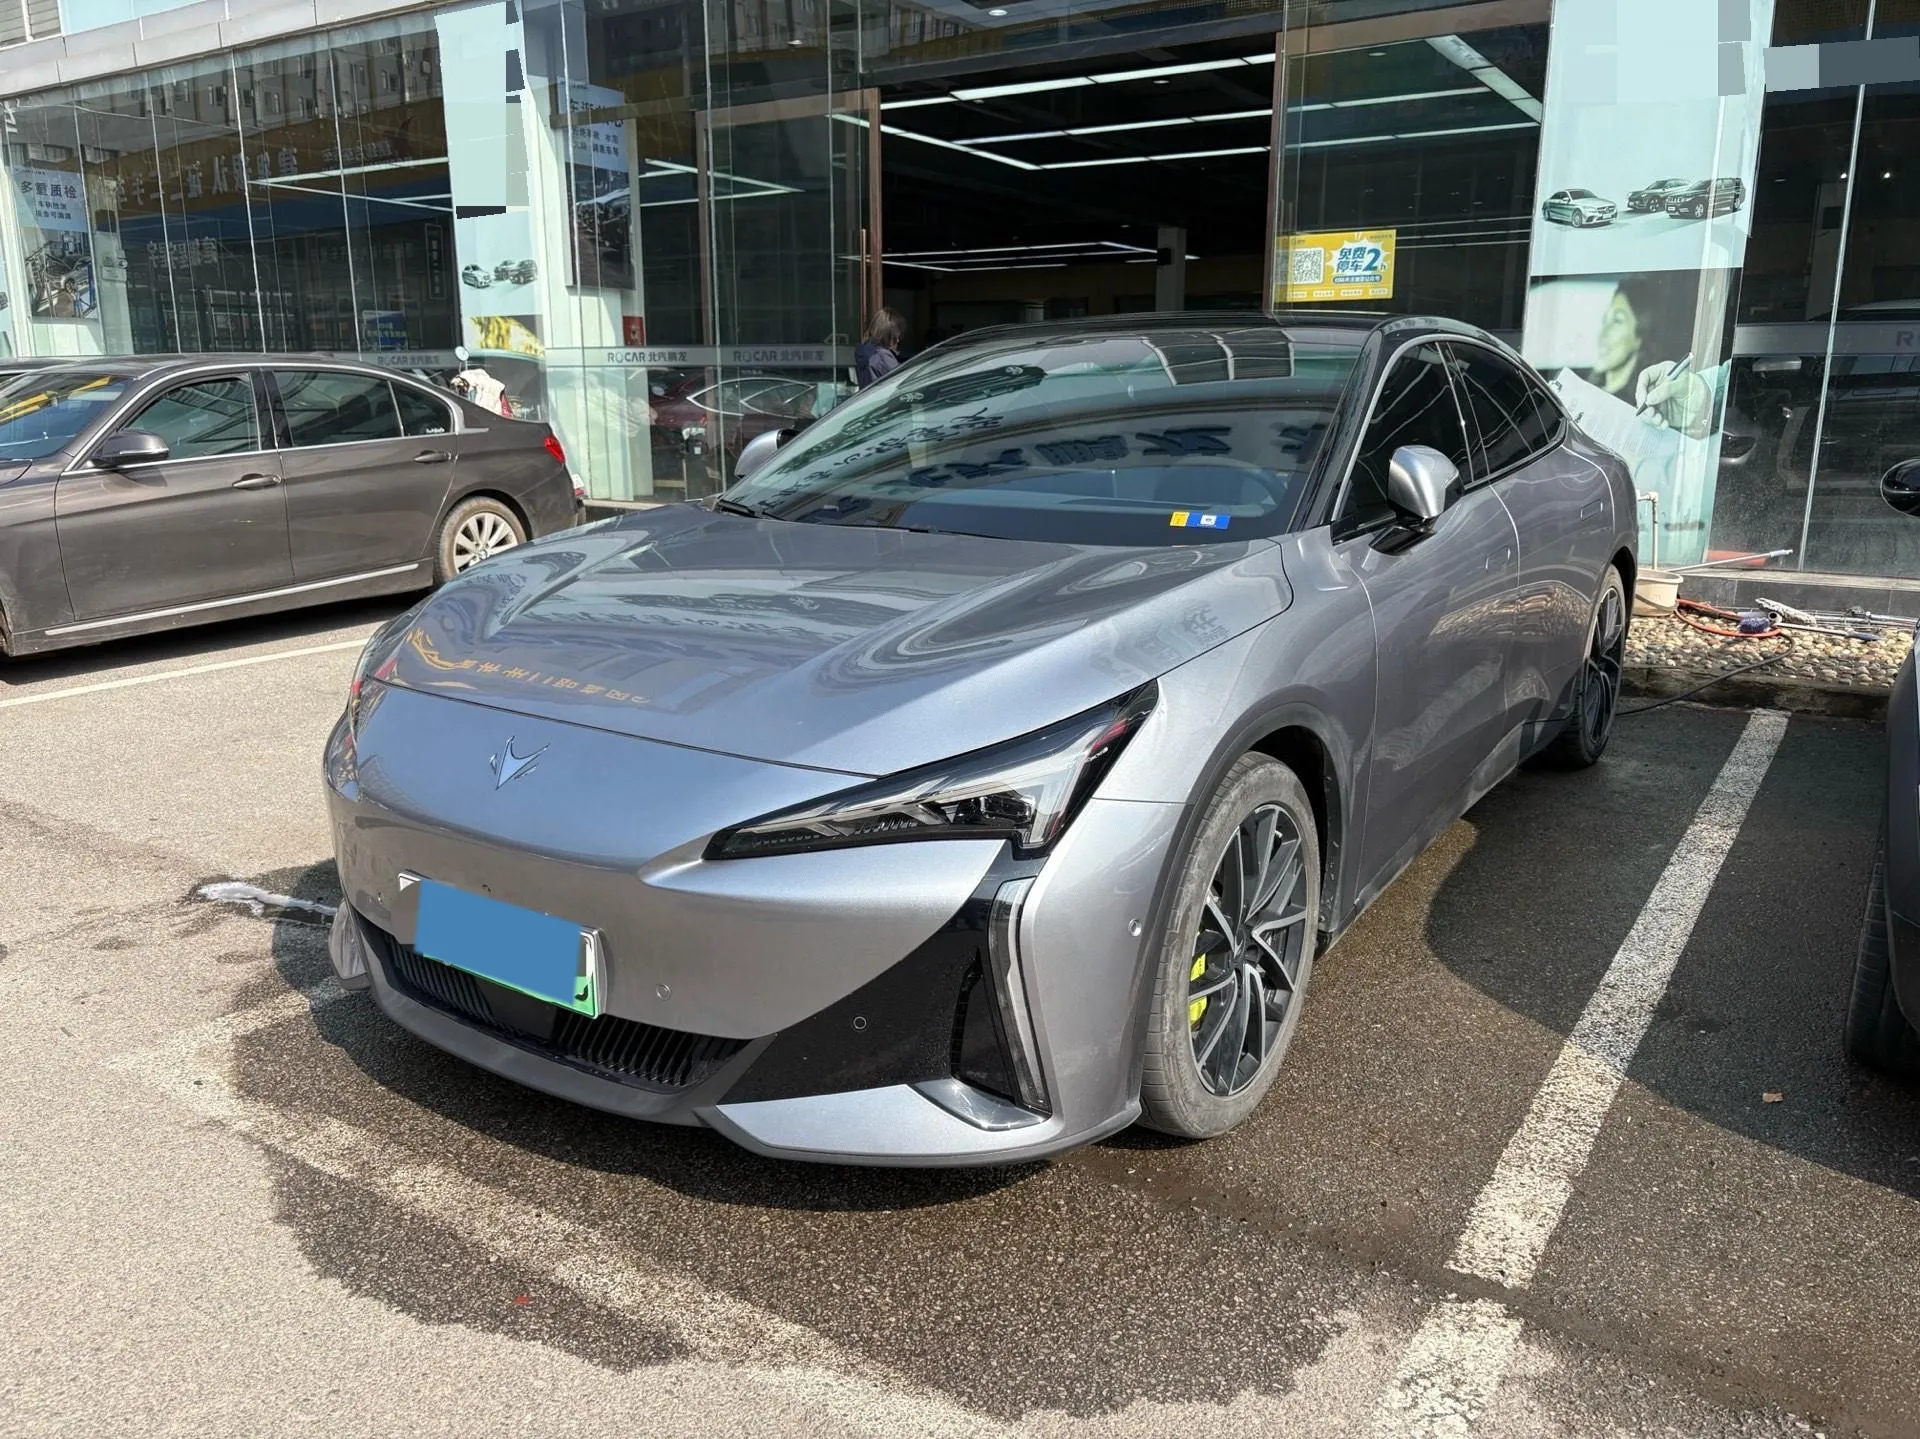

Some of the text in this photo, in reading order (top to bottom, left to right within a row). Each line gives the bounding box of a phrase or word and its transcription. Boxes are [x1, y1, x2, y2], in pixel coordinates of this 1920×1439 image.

[20, 180, 77, 198] 多重质检
[1338, 246, 1367, 260] 免费
[1336, 260, 1363, 273] 停车
[1896, 330, 1920, 347] R
